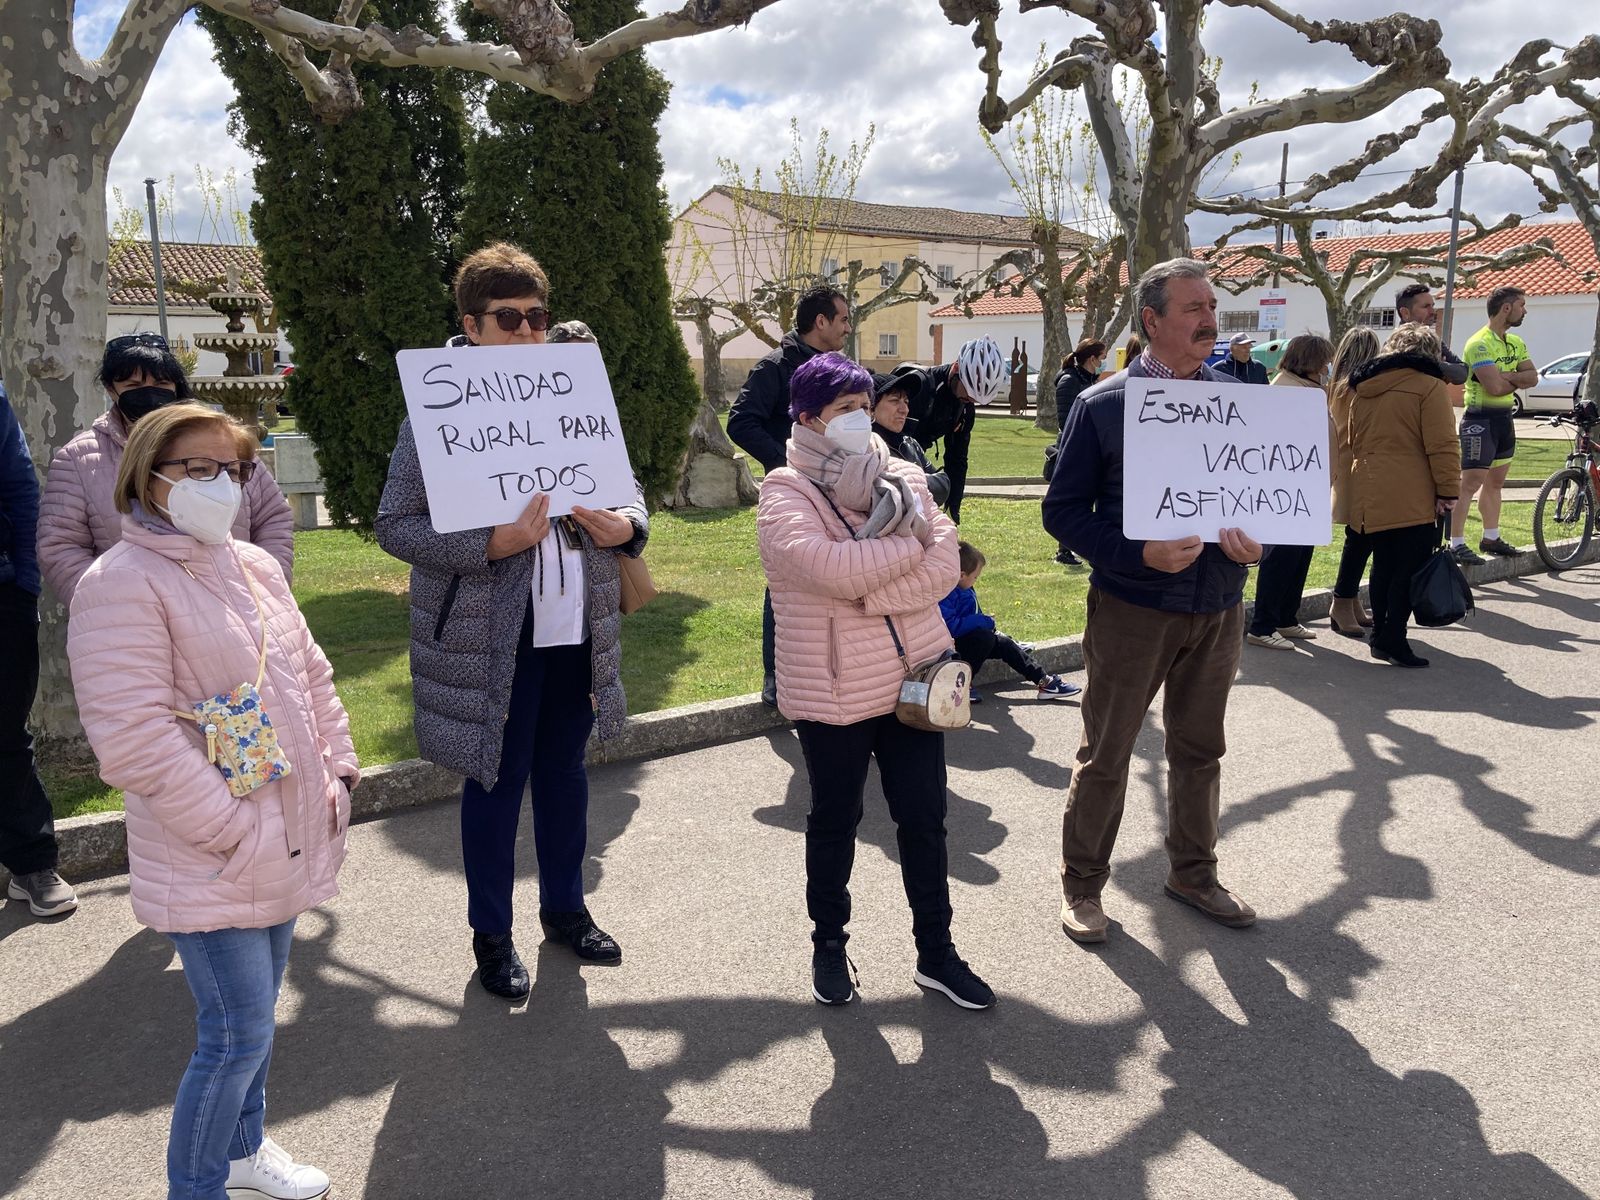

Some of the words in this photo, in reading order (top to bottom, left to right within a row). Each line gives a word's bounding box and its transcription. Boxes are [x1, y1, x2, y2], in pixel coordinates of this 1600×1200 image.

[1138, 389, 1247, 426] ESPAÑA
[437, 420, 545, 456] RURAL
[558, 414, 615, 441] PARA
[488, 463, 596, 501] TODOS
